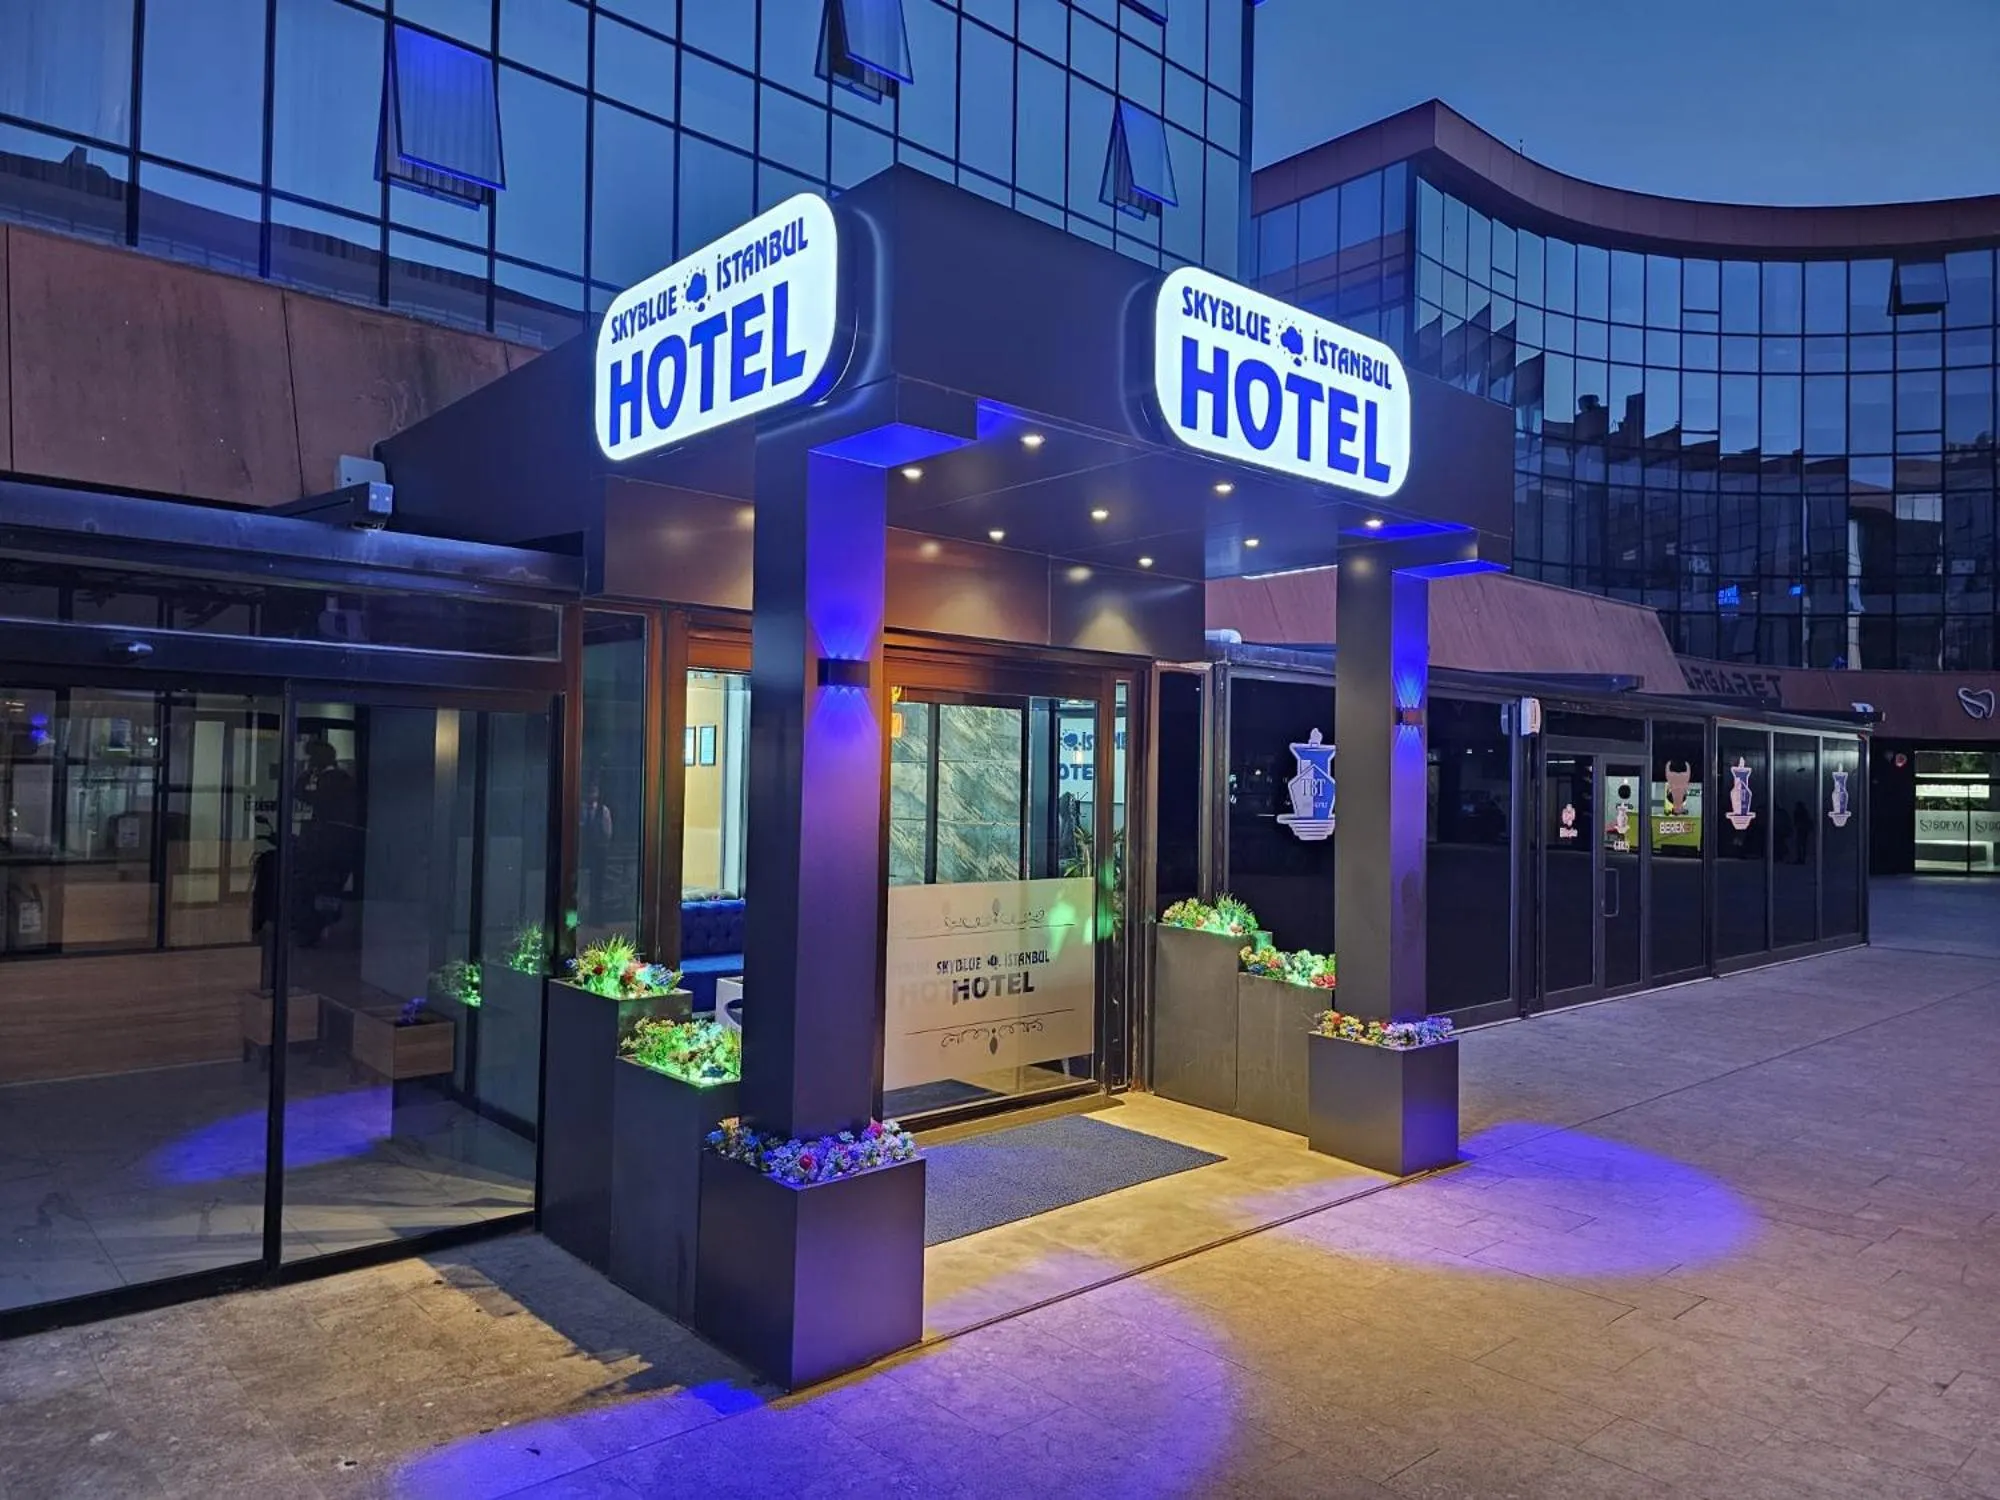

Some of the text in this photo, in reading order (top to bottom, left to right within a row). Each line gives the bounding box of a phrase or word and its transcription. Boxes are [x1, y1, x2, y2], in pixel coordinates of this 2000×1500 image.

[611, 216, 808, 344] SKYBLUE İSTANBUL
[1182, 285, 1392, 390] SKYBLUE İSTANBUL
[609, 280, 807, 447] HOTEL
[1181, 335, 1391, 484] HOTEL
[936, 956, 981, 975] SKYBLUE
[952, 970, 1035, 1006] HOTEL
